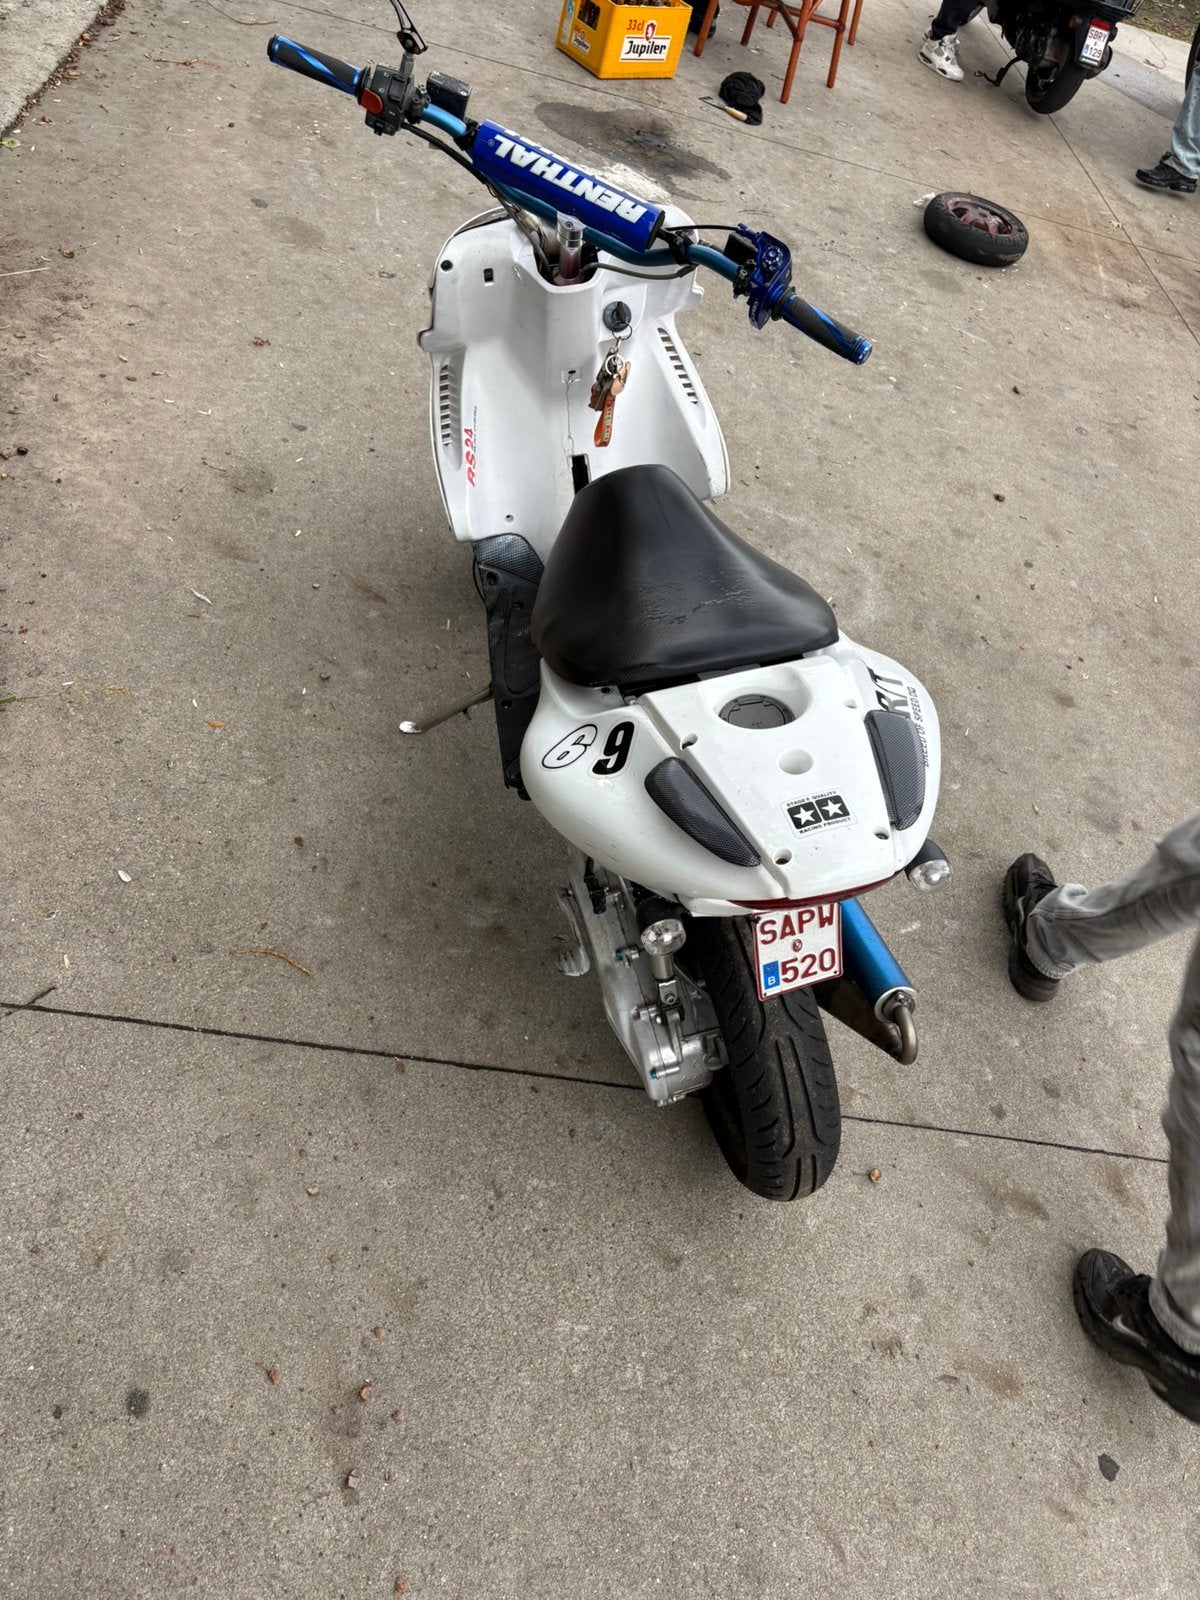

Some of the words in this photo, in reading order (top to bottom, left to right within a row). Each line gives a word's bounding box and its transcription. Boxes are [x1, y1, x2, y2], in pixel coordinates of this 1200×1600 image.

[626, 20, 645, 31] 33cl
[624, 41, 667, 57] Jupiler
[493, 134, 648, 224] RENTHAL
[911, 698, 923, 722] SPEED
[811, 790, 837, 800] QUALITY
[799, 824, 823, 834] RACING
[823, 817, 851, 827] PRODUCT
[760, 902, 835, 945] SAPW
[767, 976, 776, 986] B
[780, 947, 836, 983] 520
